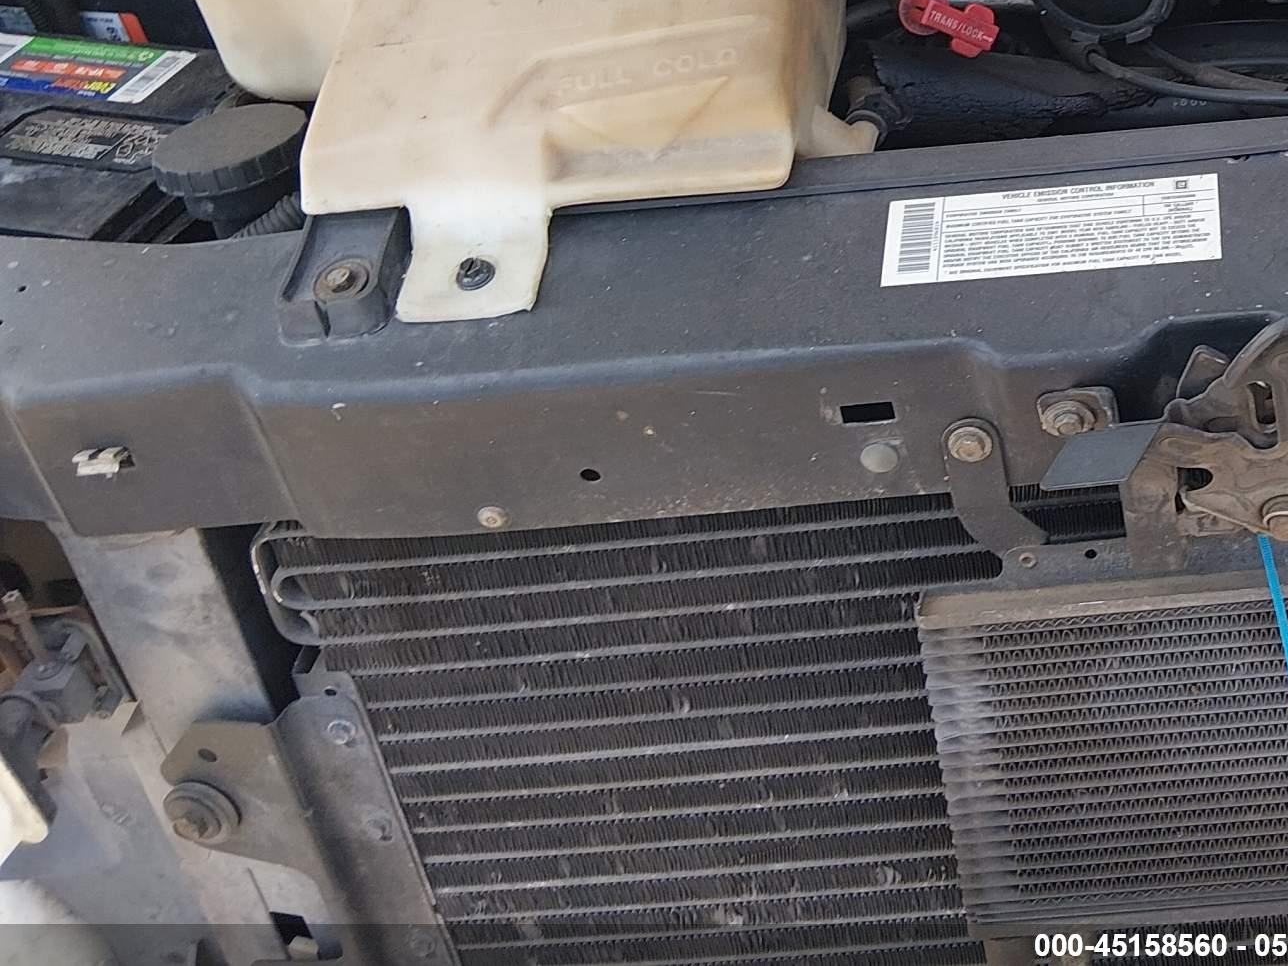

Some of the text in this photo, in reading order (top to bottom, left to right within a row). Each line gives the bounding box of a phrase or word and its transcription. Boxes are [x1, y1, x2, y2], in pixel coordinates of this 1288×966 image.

[930, 10, 984, 41] TRANS/LOCK
[557, 47, 740, 92] FULL COLD
[1001, 180, 1154, 200] VEHICLE EMISSION CONTROL INFORMATION
